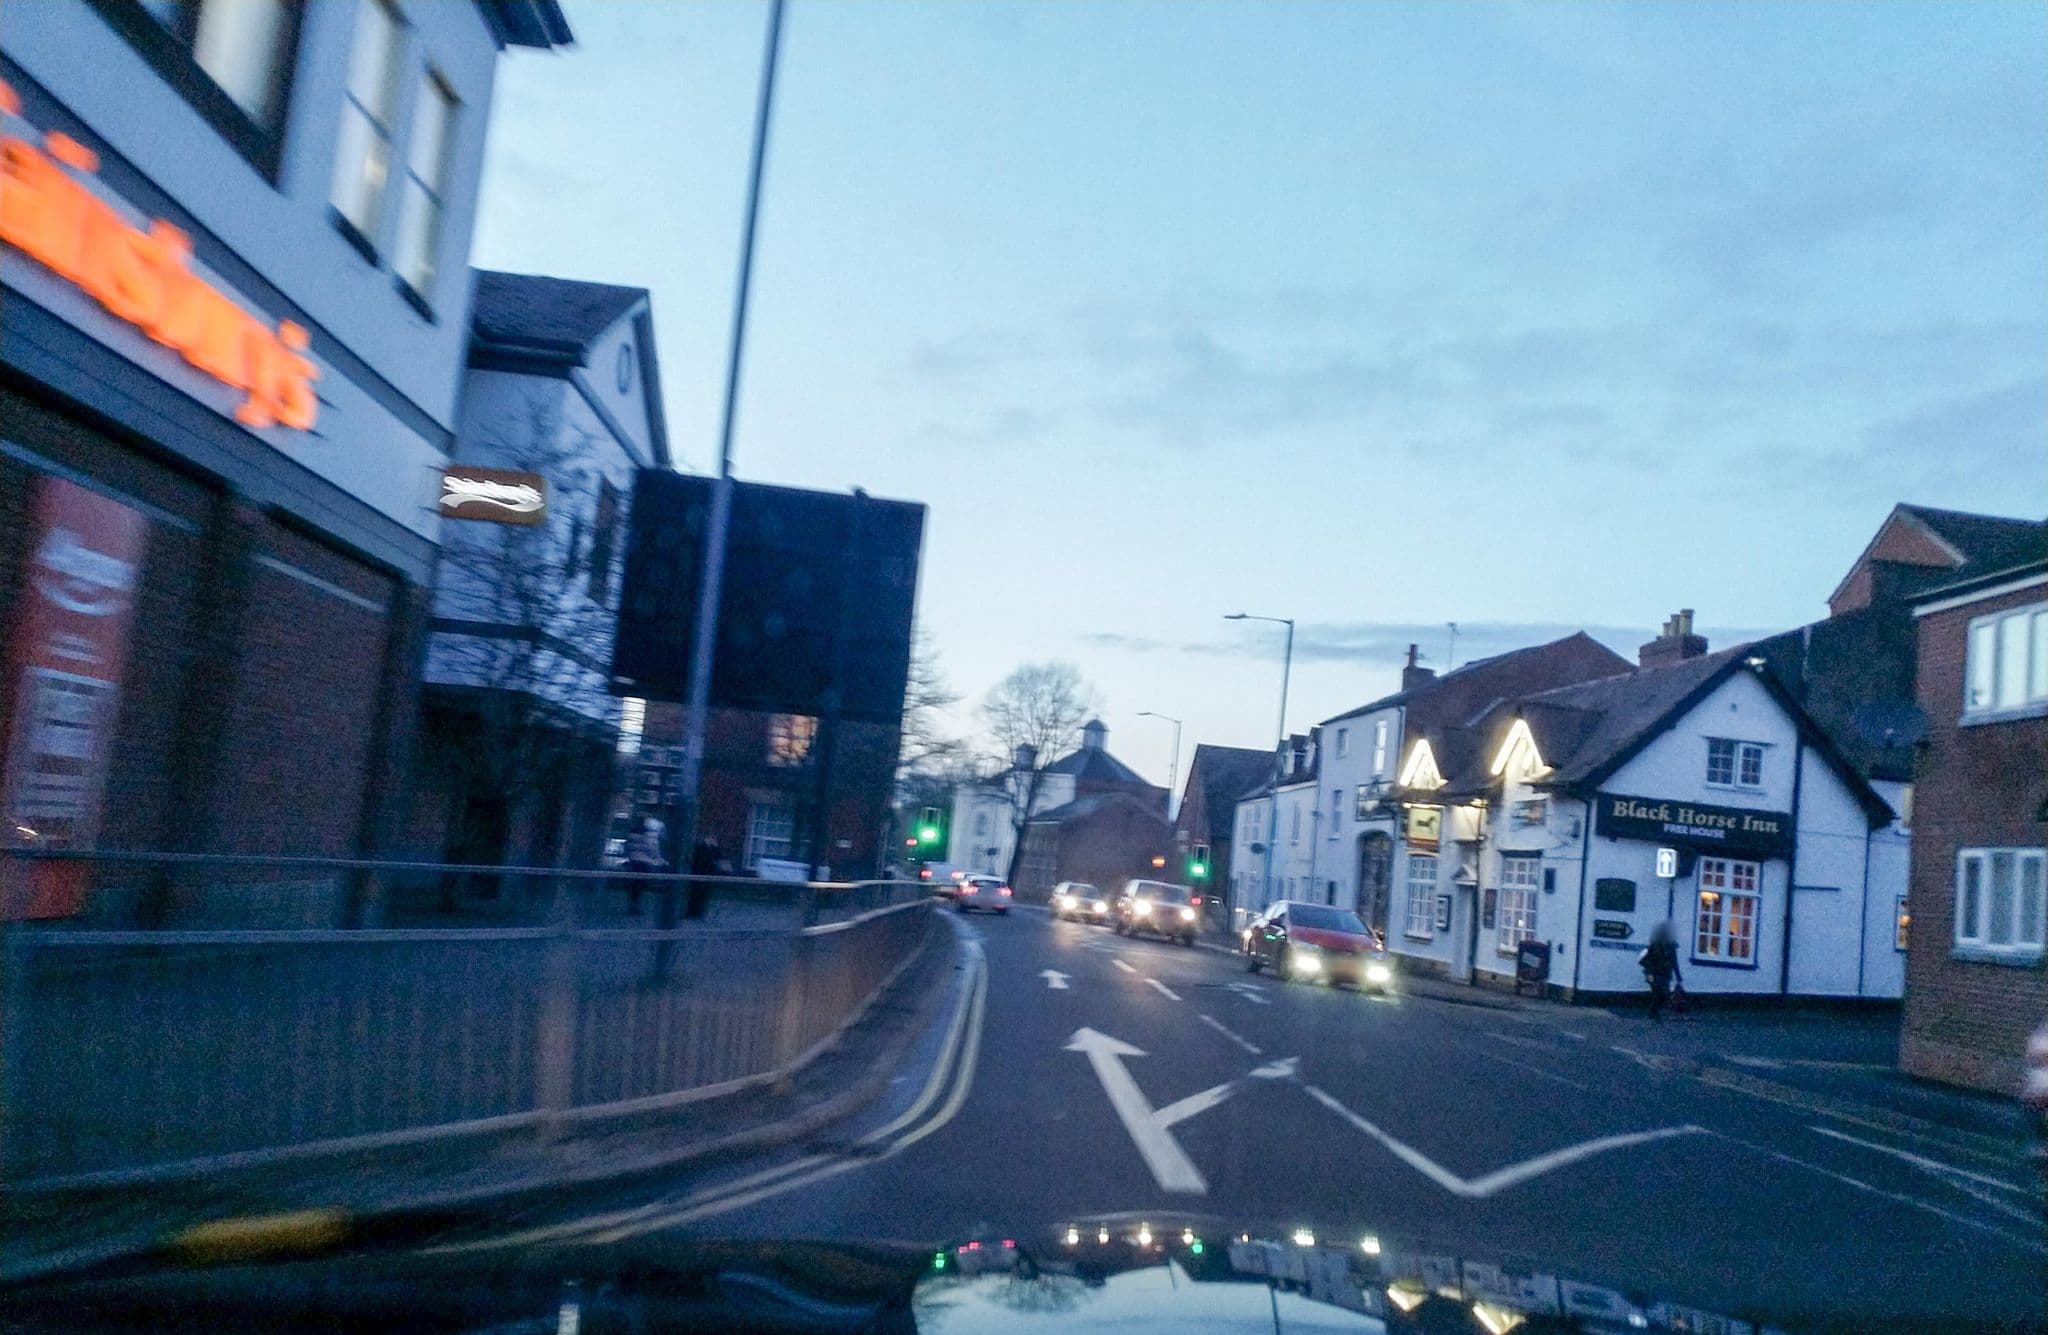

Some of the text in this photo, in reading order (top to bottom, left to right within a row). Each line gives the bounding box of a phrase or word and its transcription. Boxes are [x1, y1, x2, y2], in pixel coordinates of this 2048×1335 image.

[1612, 800, 1780, 833] Black Horse Inn
[1663, 823, 1726, 839] FREE HOUSE
